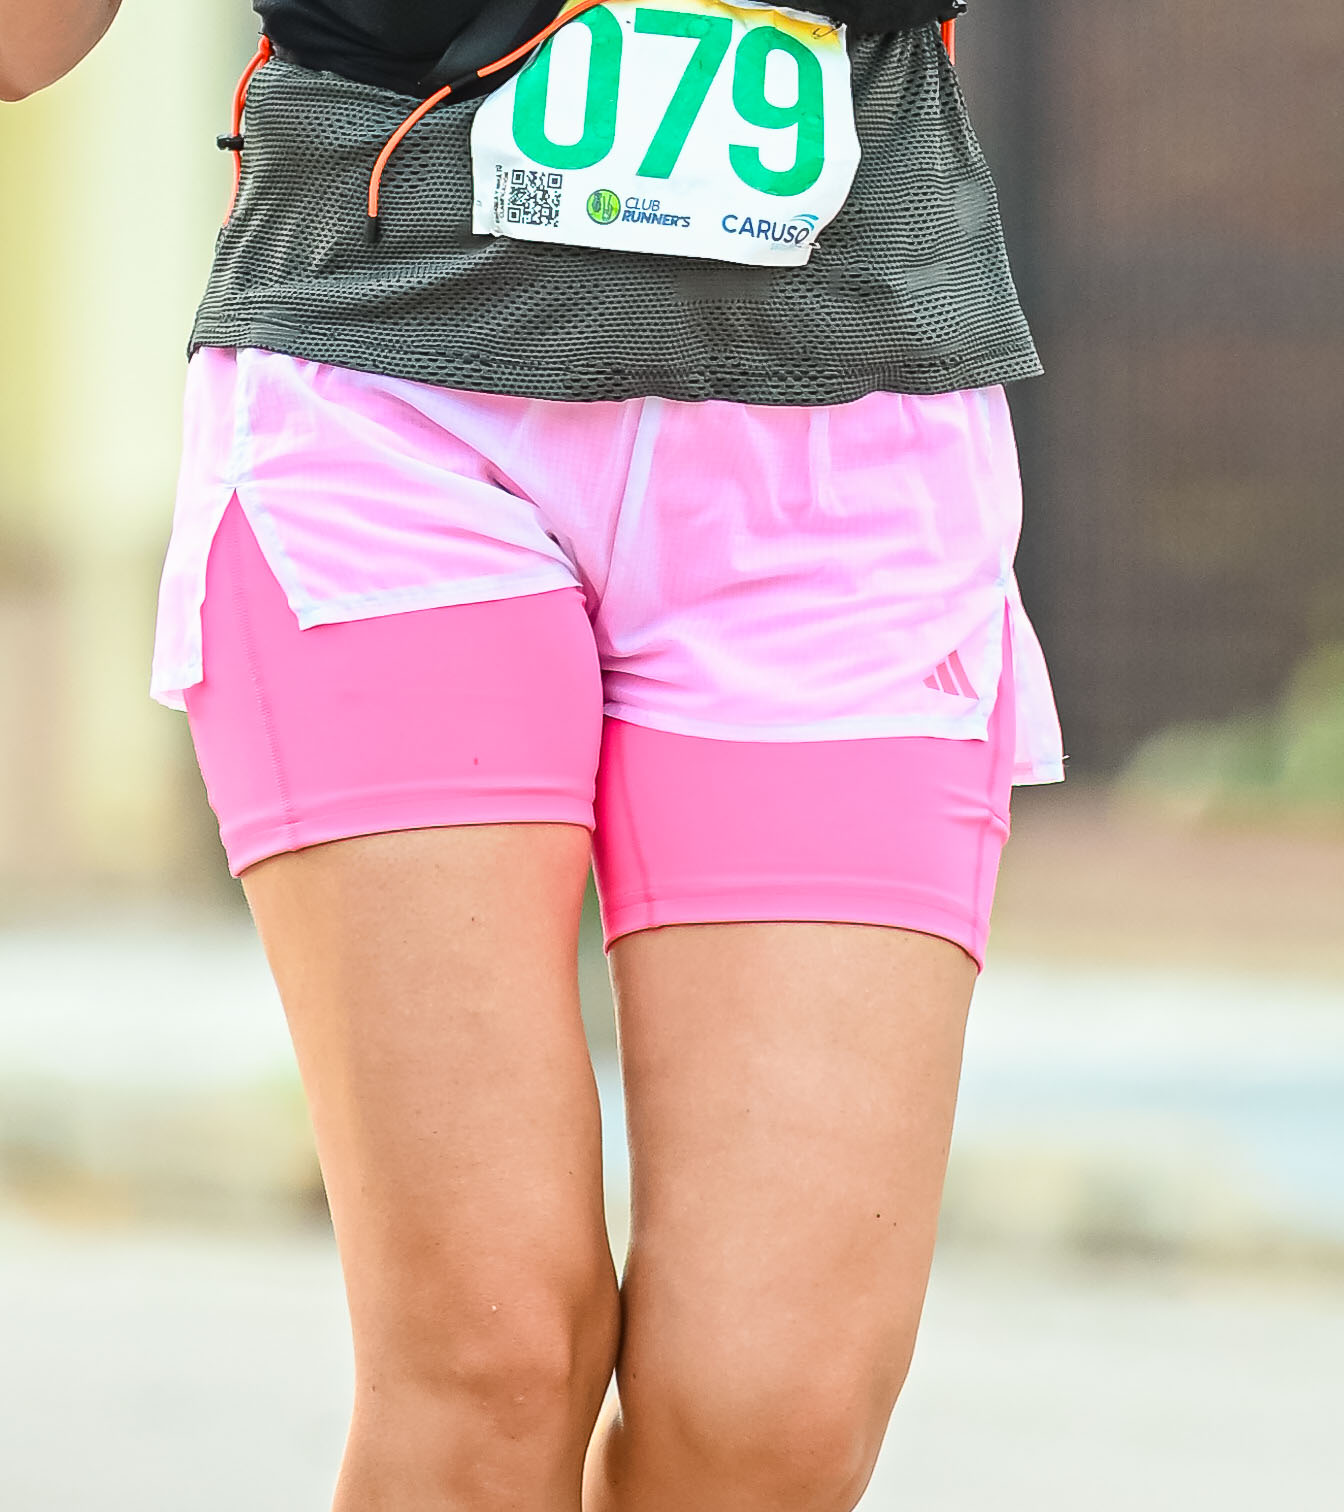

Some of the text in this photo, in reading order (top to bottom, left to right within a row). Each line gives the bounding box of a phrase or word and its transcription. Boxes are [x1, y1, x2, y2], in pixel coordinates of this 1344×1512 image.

[512, 4, 824, 196] 079
[625, 196, 661, 212] CLUB
[722, 214, 810, 245] CARUSO
